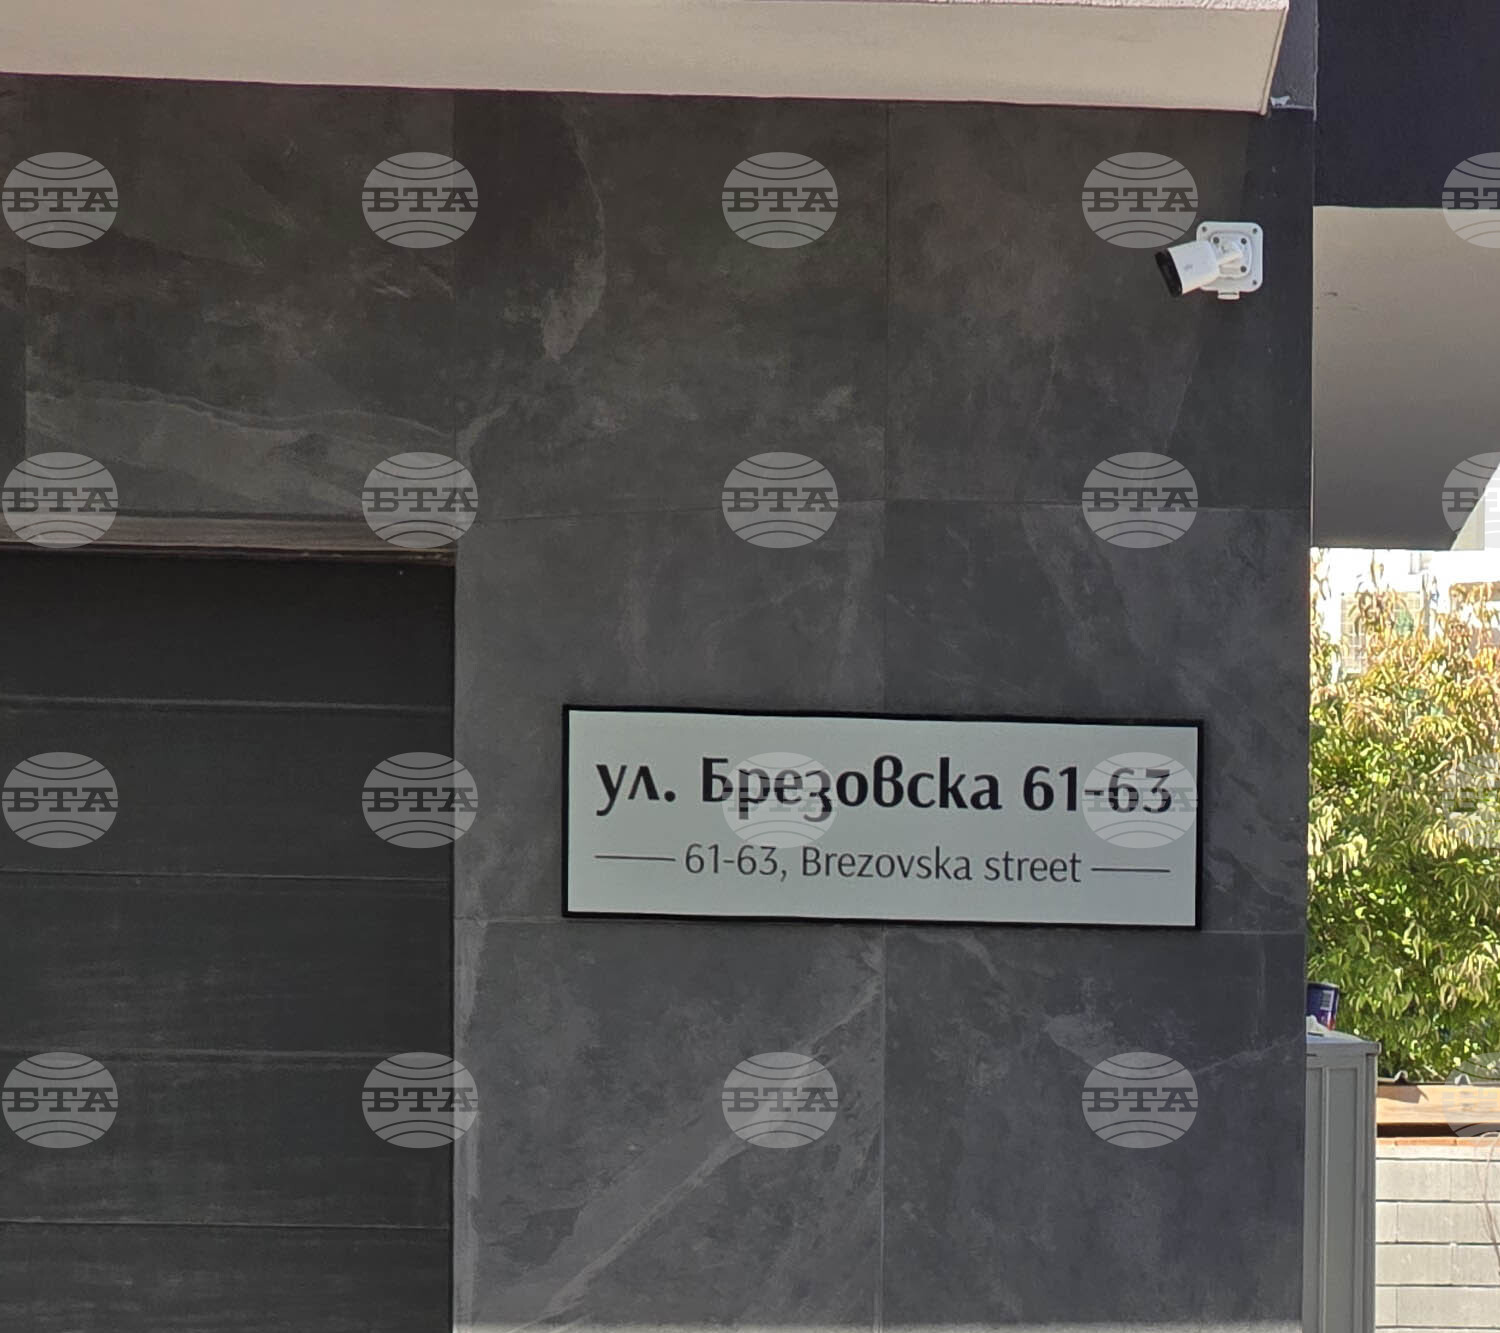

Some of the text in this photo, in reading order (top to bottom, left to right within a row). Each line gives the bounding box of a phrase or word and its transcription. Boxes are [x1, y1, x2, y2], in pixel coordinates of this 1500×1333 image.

[596, 755, 1174, 822] ул. Брезовска 61-63
[684, 842, 1082, 882] 61-63, Brezovska street
